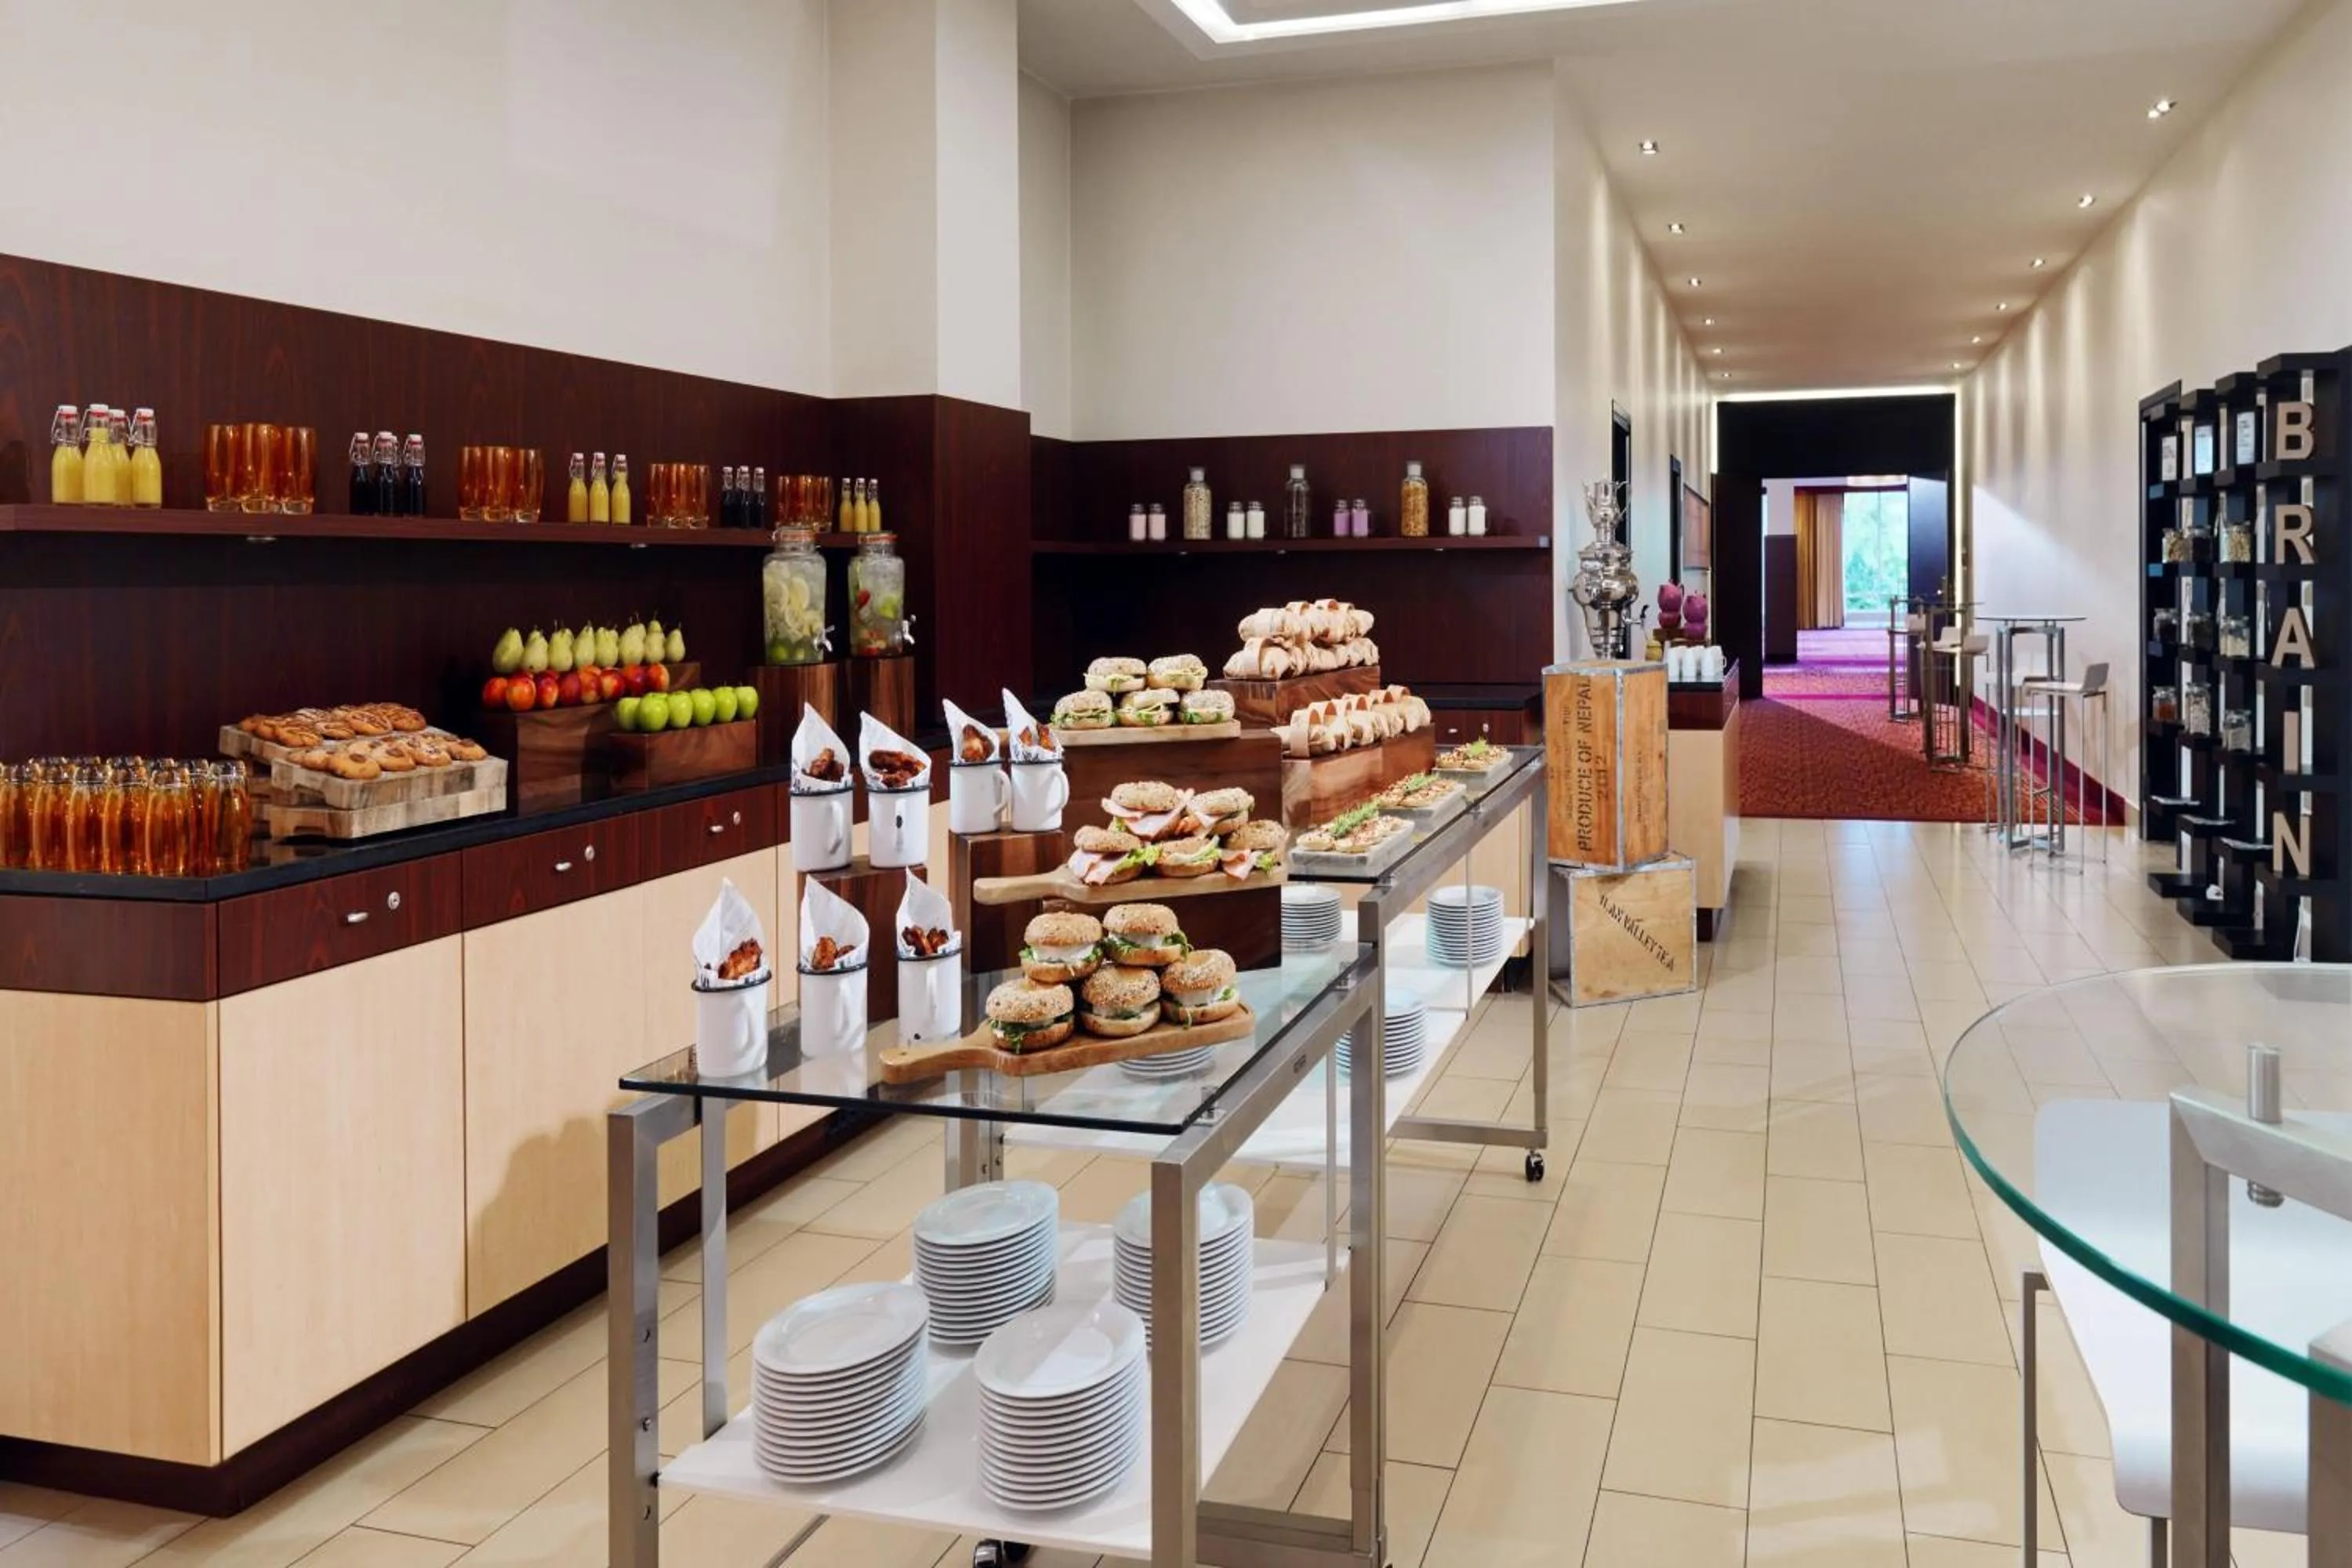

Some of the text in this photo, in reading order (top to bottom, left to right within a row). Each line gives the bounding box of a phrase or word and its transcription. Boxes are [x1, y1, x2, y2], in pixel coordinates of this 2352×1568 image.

[2271, 401, 2316, 877] BRAIN
[1577, 676, 1592, 852] PRODUCE OF NEPAL
[1595, 755, 1609, 800] 2012
[1623, 914, 1658, 953] VALLEY
[1655, 944, 1674, 972] TEA
